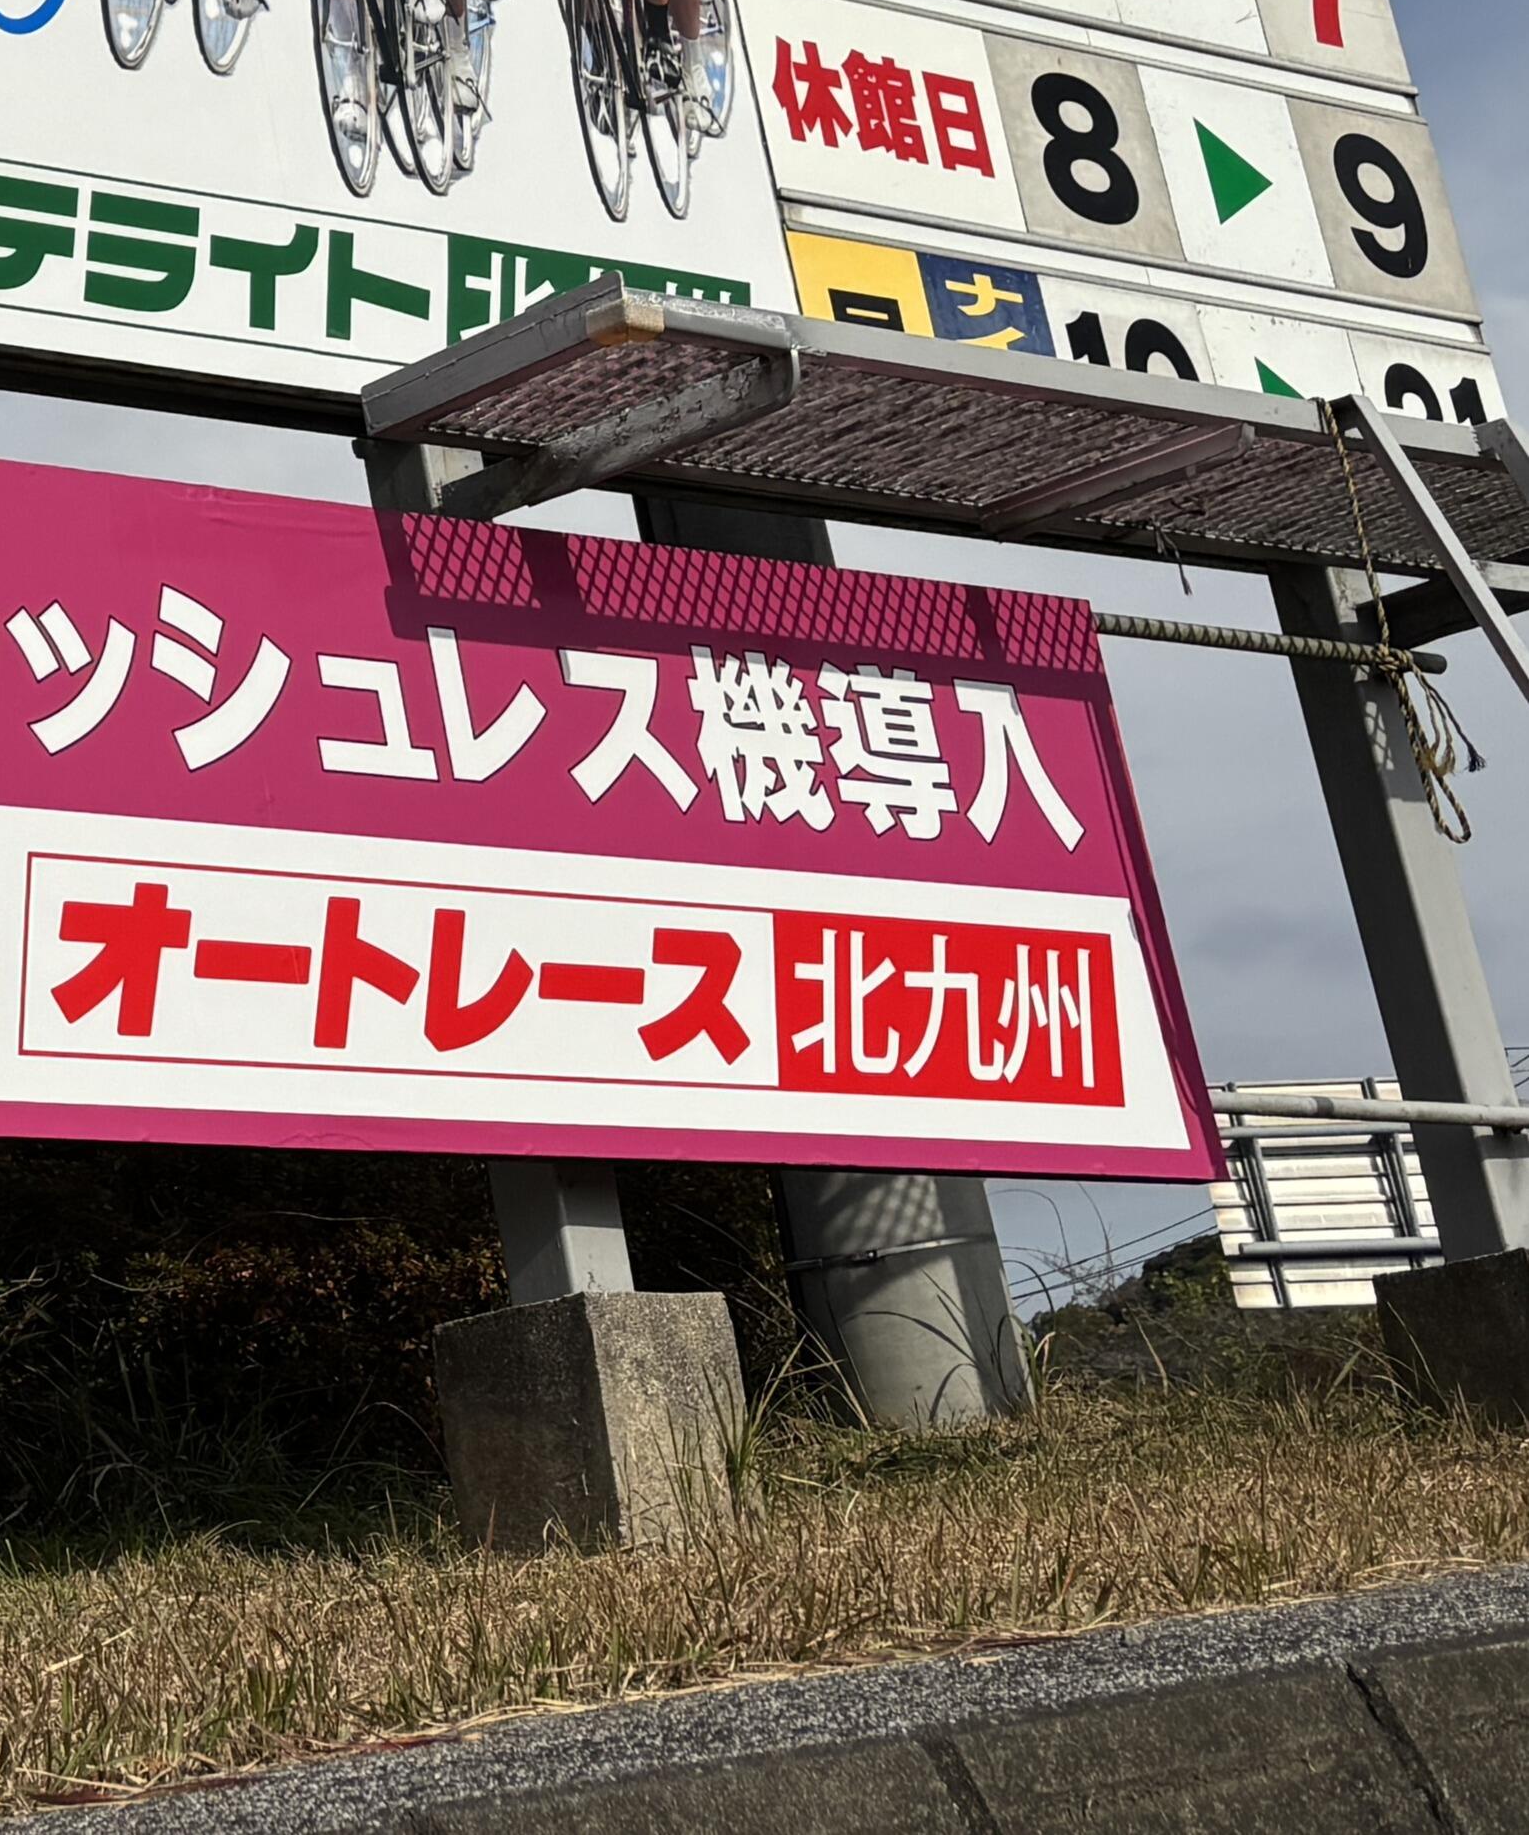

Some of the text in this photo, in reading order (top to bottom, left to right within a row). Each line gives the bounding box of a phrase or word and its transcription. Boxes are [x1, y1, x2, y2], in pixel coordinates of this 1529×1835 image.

[770, 35, 996, 179] 休館日
[1030, 71, 1140, 226] 8
[1331, 132, 1428, 278] 9
